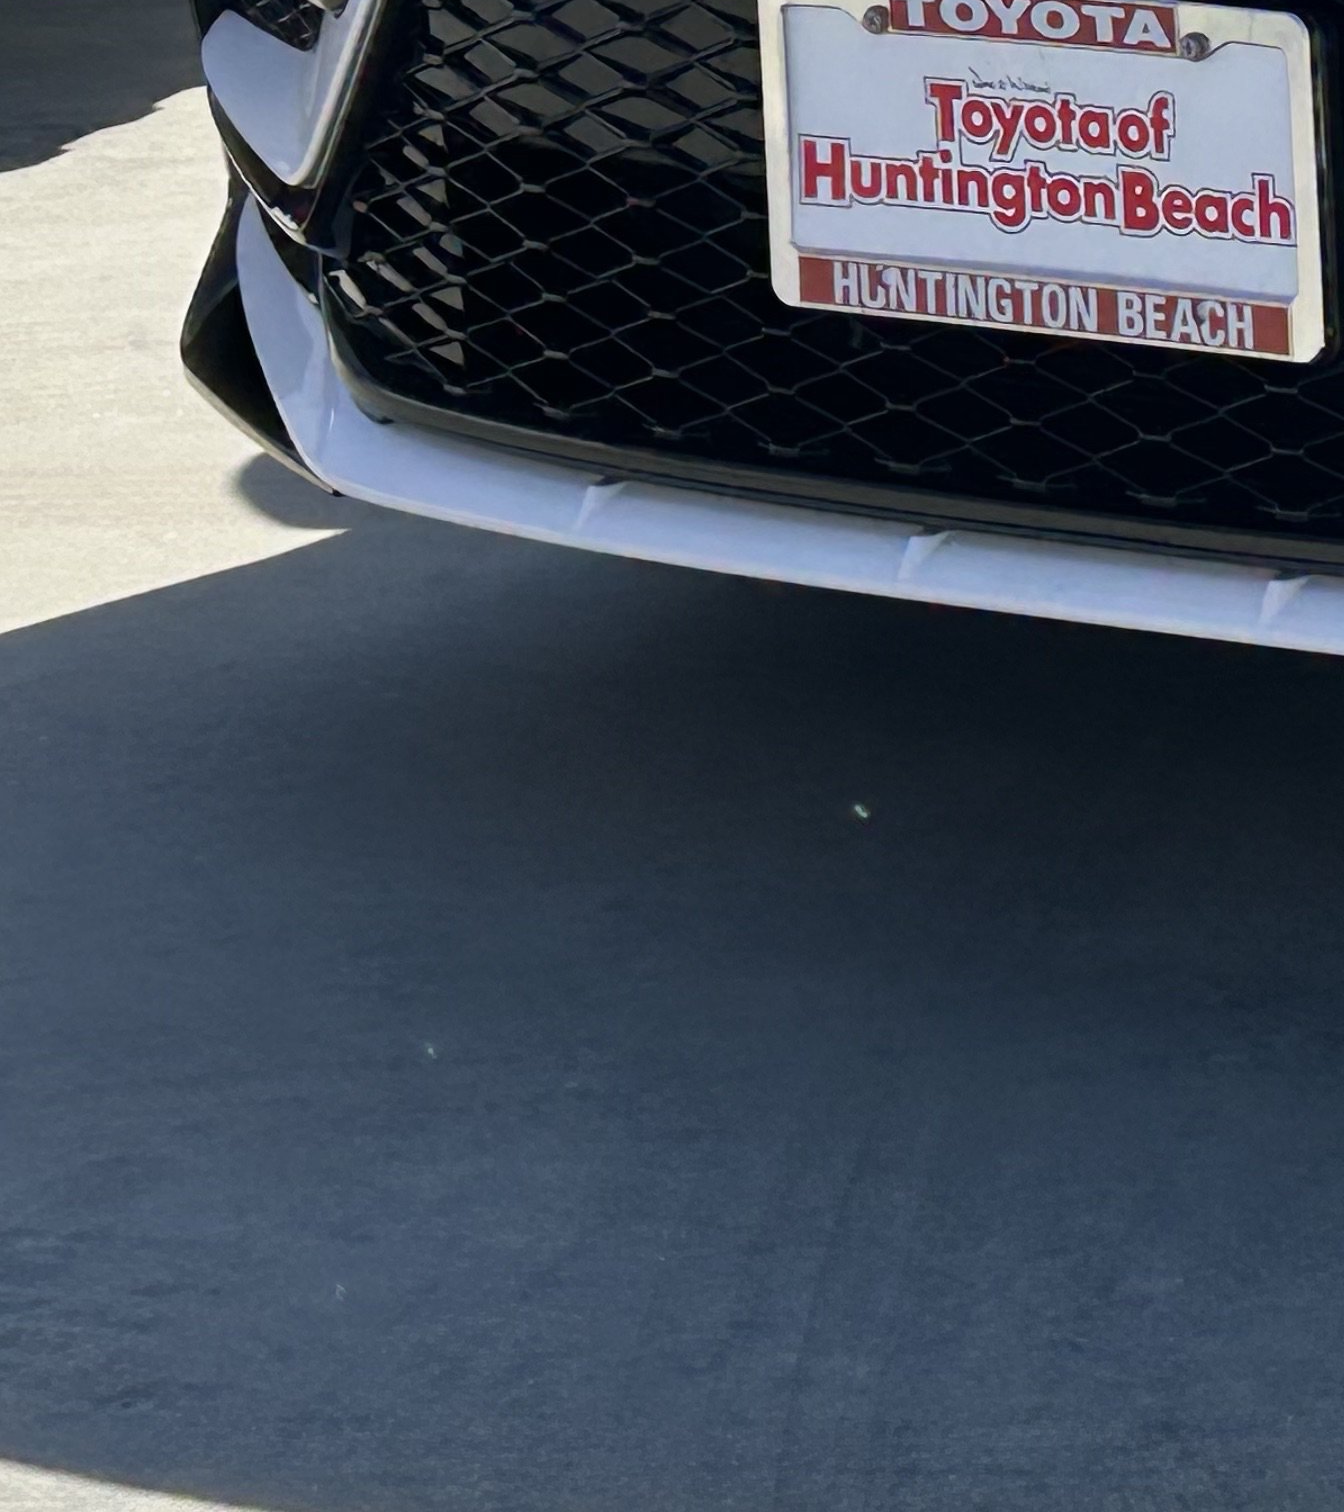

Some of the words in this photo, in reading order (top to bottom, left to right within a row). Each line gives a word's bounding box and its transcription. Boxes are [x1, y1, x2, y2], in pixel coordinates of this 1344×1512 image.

[928, 82, 1110, 157] Toyota
[1115, 95, 1171, 155] of
[802, 139, 1116, 227] Huntington
[1123, 171, 1292, 240] Beach
[833, 260, 1098, 333] HUNTINGTON
[1118, 294, 1255, 350] BEACH
